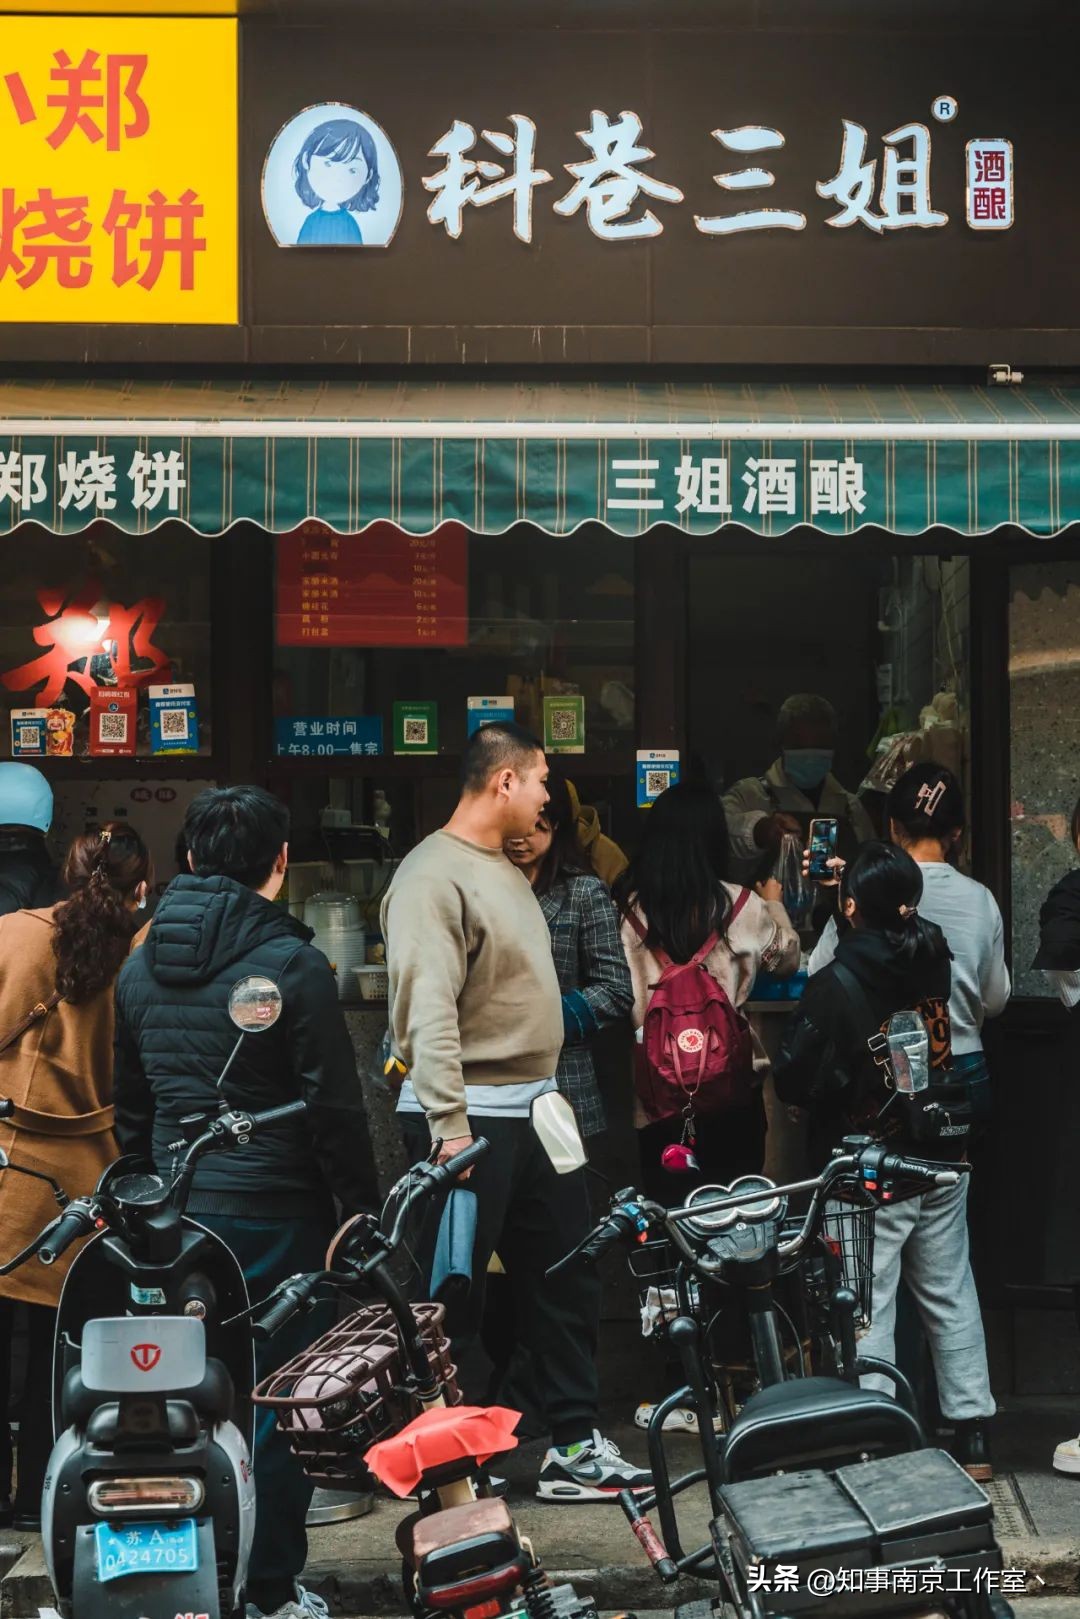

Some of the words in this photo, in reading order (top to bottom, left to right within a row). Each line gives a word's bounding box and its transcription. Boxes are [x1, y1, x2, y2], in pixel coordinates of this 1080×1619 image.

[421, 109, 949, 244] 科巷三姐
[974, 150, 1005, 220] 酒酿
[0, 188, 206, 291] 烧饼
[607, 455, 867, 515] 三姐酒酿
[292, 721, 357, 736] 营业时间
[126, 1531, 142, 1546] 苏
[149, 1530, 165, 1545] A
